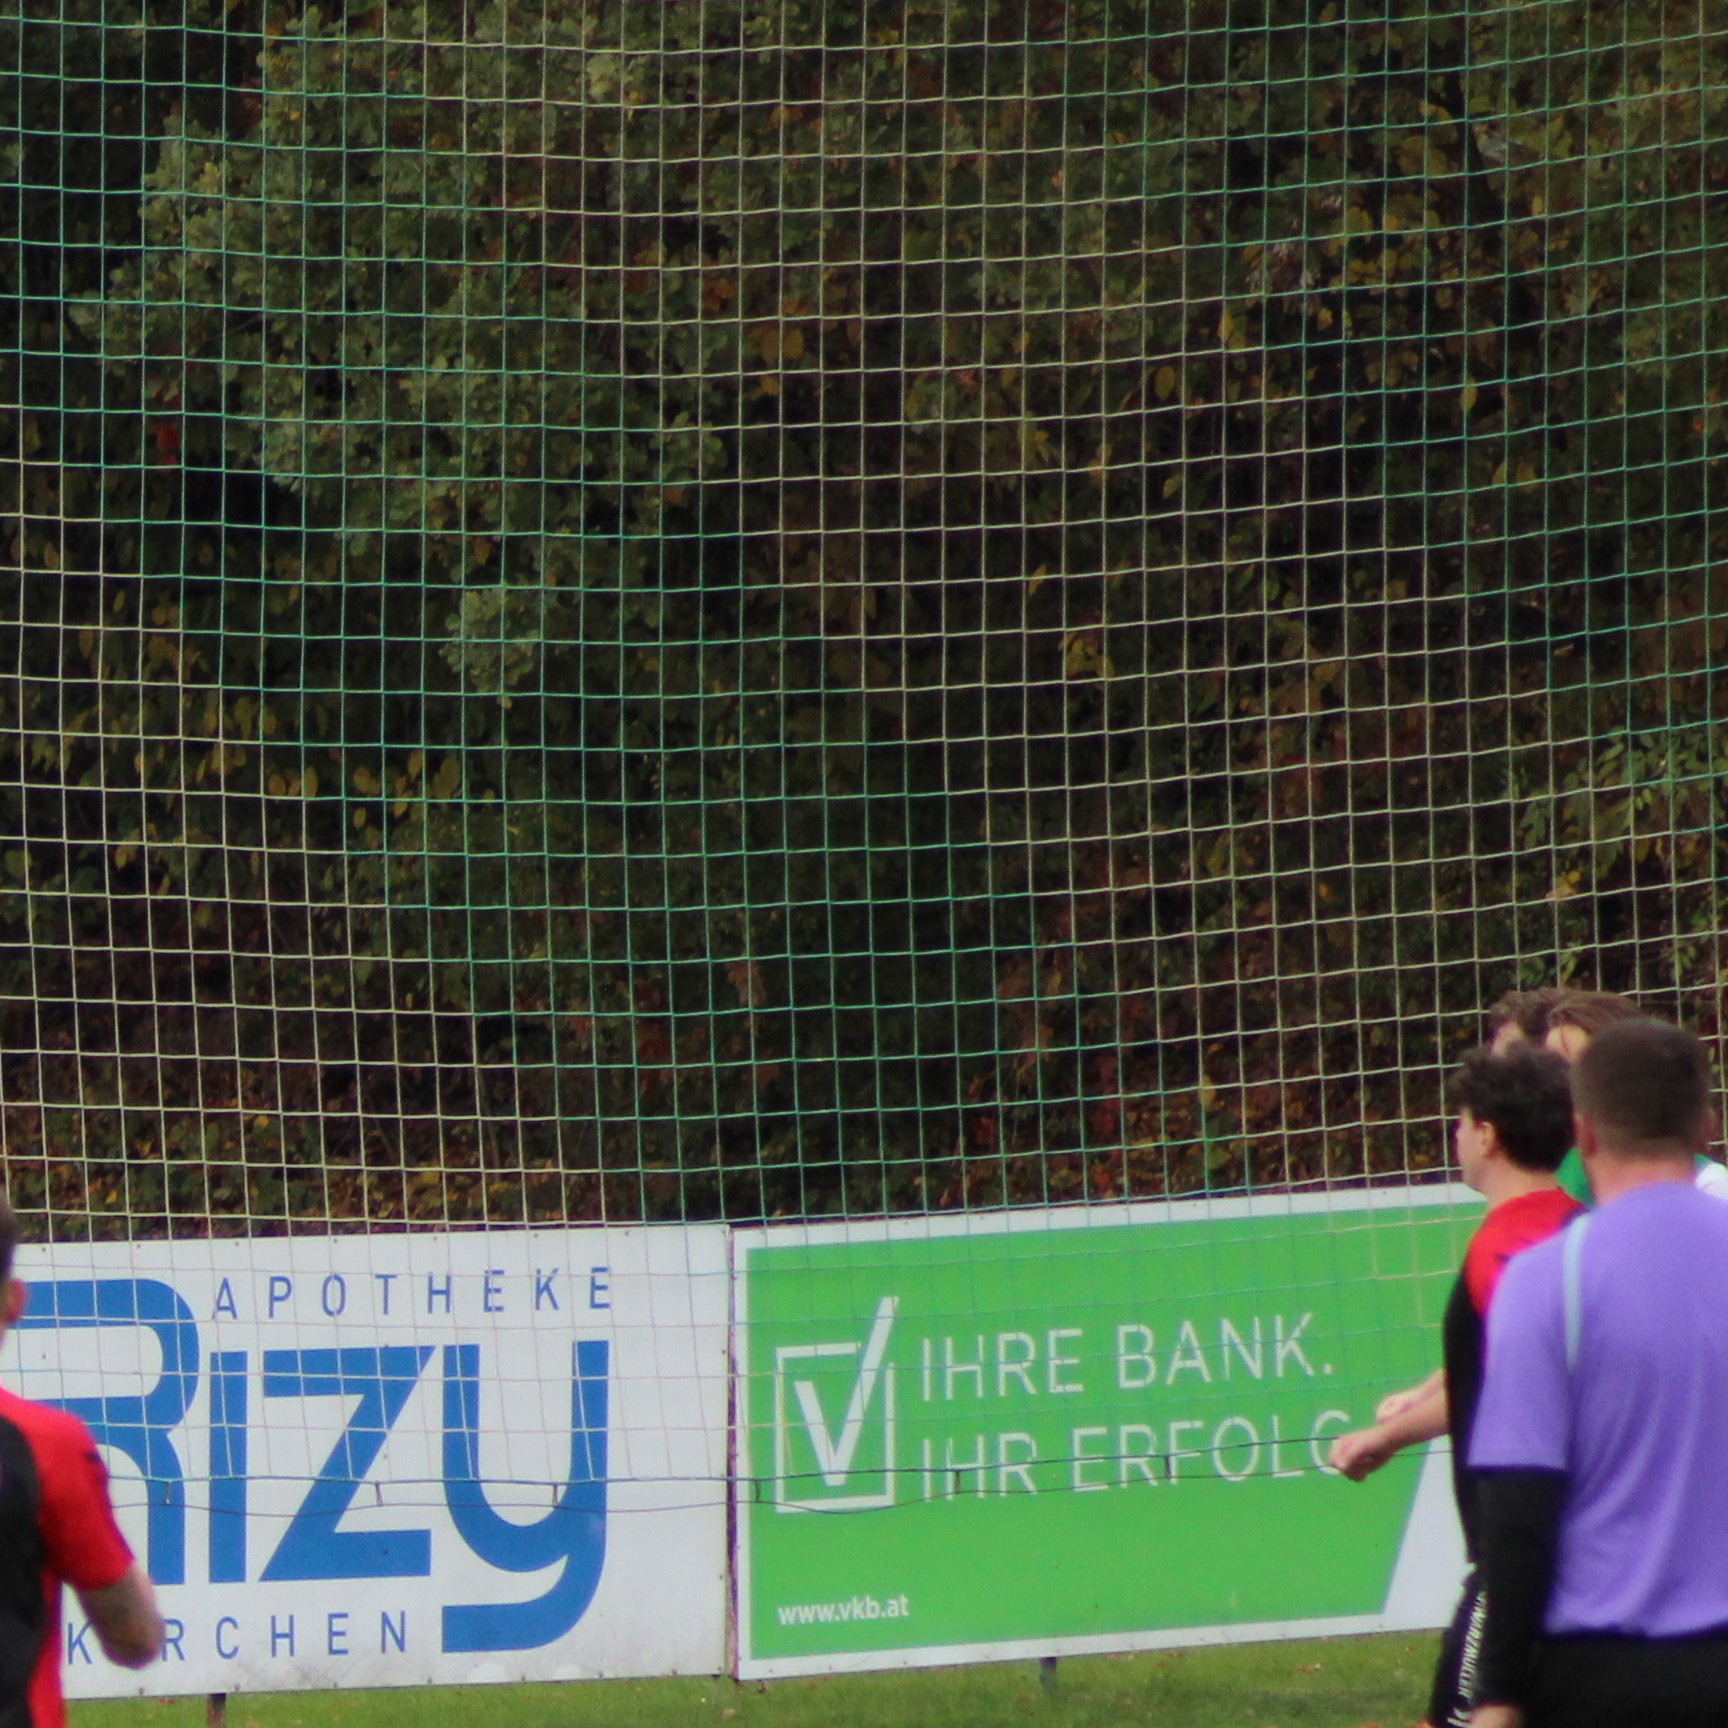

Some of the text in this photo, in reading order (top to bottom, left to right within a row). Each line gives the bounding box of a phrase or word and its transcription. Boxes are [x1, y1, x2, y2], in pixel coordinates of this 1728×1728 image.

[210, 1266, 613, 1320] APOTHEKE
[922, 1312, 1335, 1403] IHRE BANK.
[922, 1432, 1037, 1502] IHR
[777, 1593, 909, 1626] www.vkb.at
